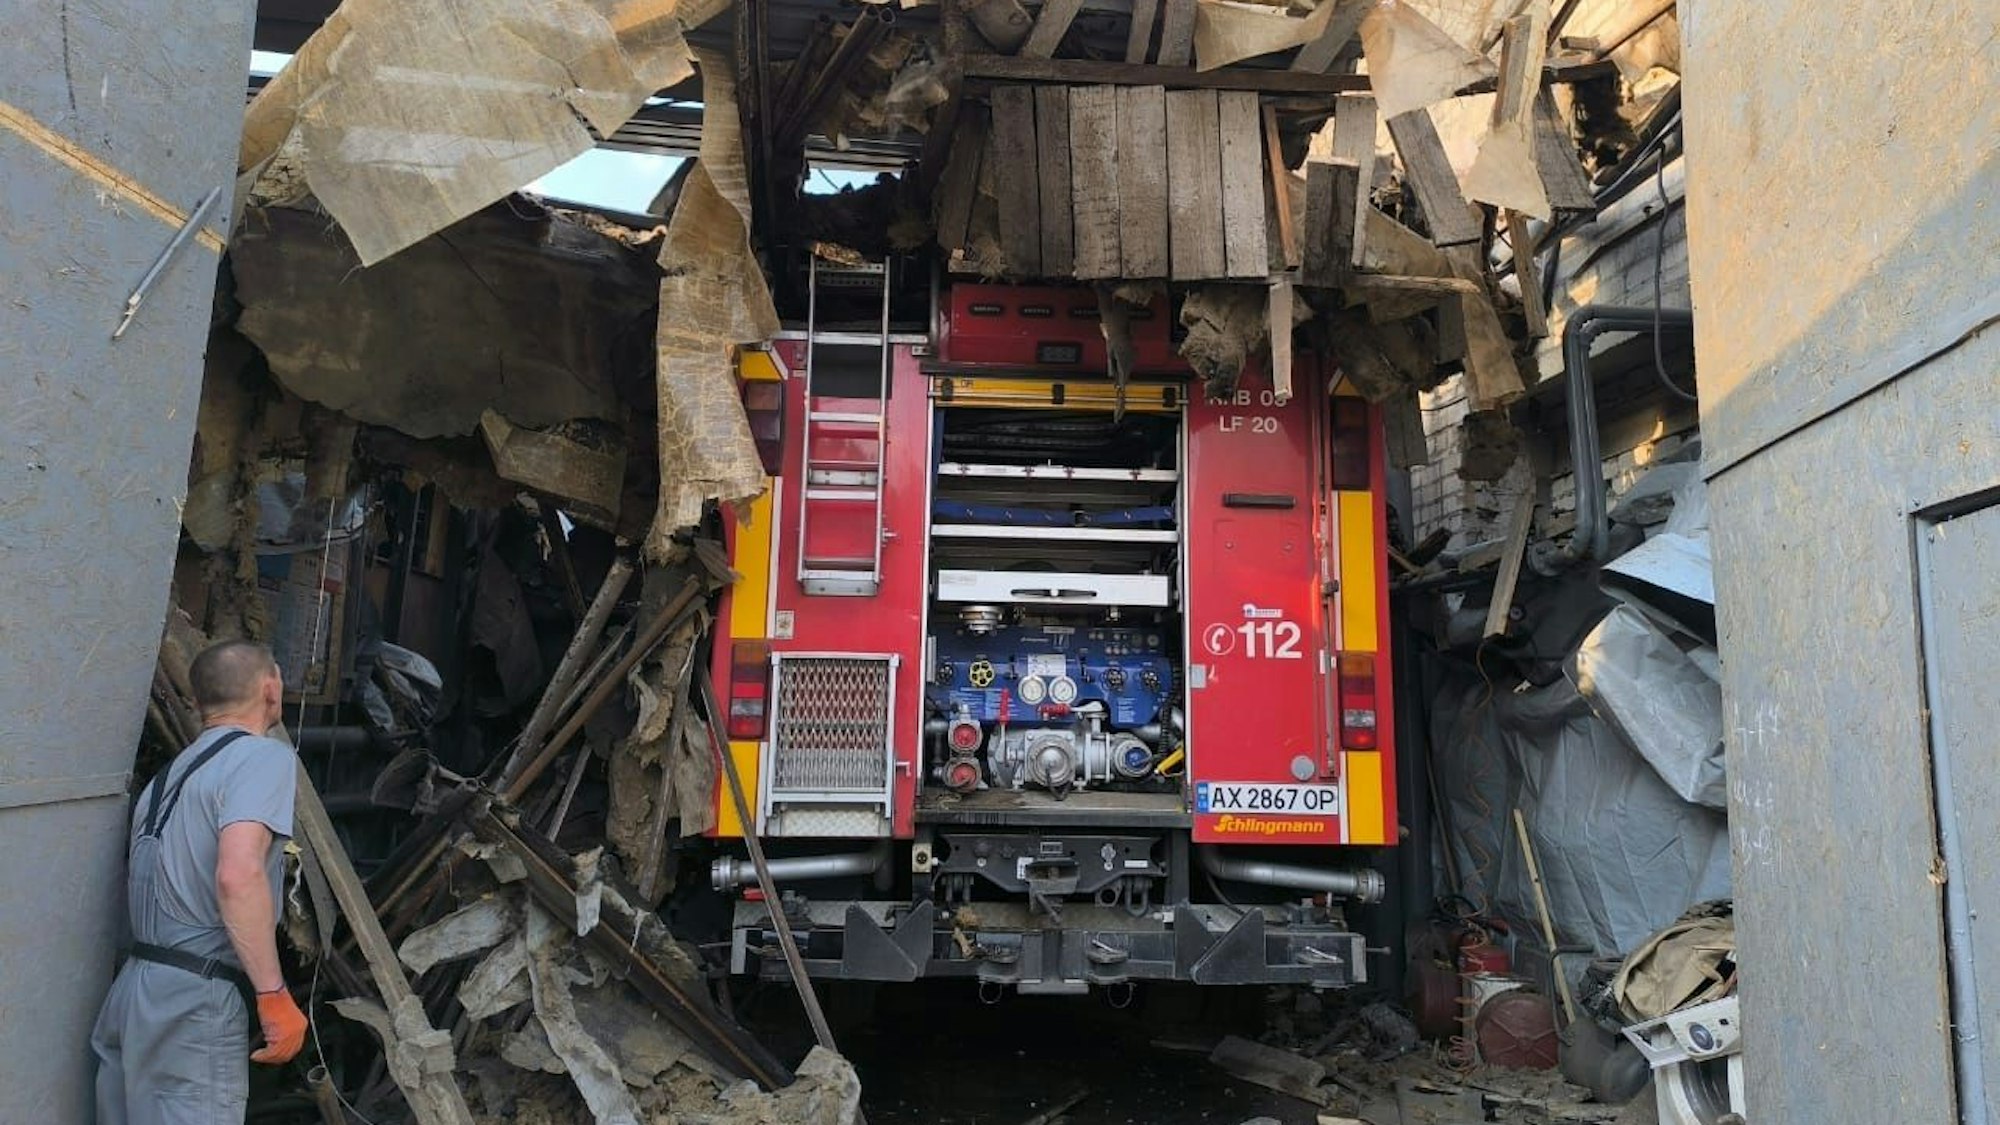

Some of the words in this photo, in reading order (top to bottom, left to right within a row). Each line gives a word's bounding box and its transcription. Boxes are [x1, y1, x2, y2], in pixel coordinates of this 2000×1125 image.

[1220, 416, 1243, 432] LF
[1252, 417, 1278, 433] 20
[1238, 621, 1302, 658] 112
[1212, 788, 1242, 808] AX
[1248, 789, 1298, 809] 2867
[1304, 790, 1334, 810] OP
[1214, 815, 1324, 834] Schlingmann
